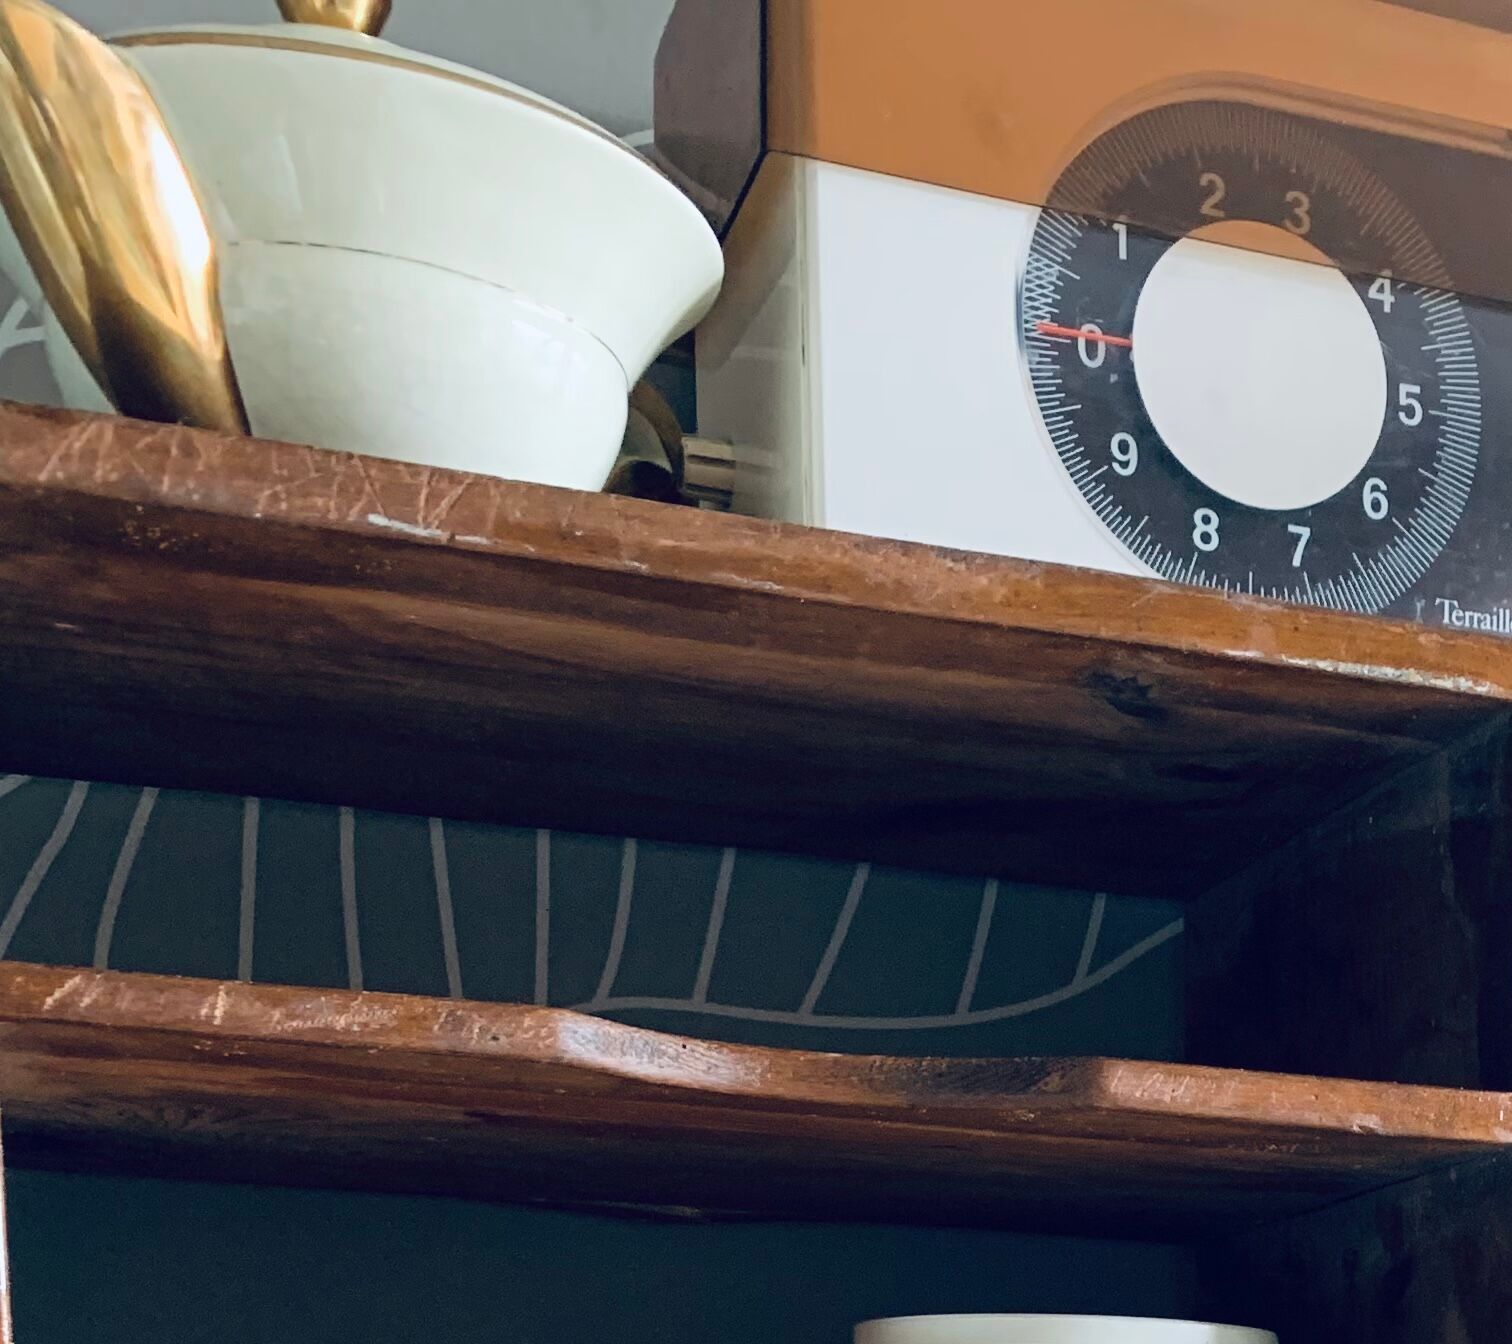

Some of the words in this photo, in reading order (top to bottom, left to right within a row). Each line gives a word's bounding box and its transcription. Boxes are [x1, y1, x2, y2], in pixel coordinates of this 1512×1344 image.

[1199, 173, 1226, 217] 2
[1284, 190, 1312, 235] 3
[1112, 222, 1129, 261] 1
[1368, 270, 1396, 314] 4
[1077, 322, 1106, 369] 0
[1398, 383, 1424, 426] 5
[1110, 432, 1139, 477] 9
[1362, 478, 1389, 521] 6
[1192, 507, 1221, 552] 8
[1287, 525, 1312, 568] 7
